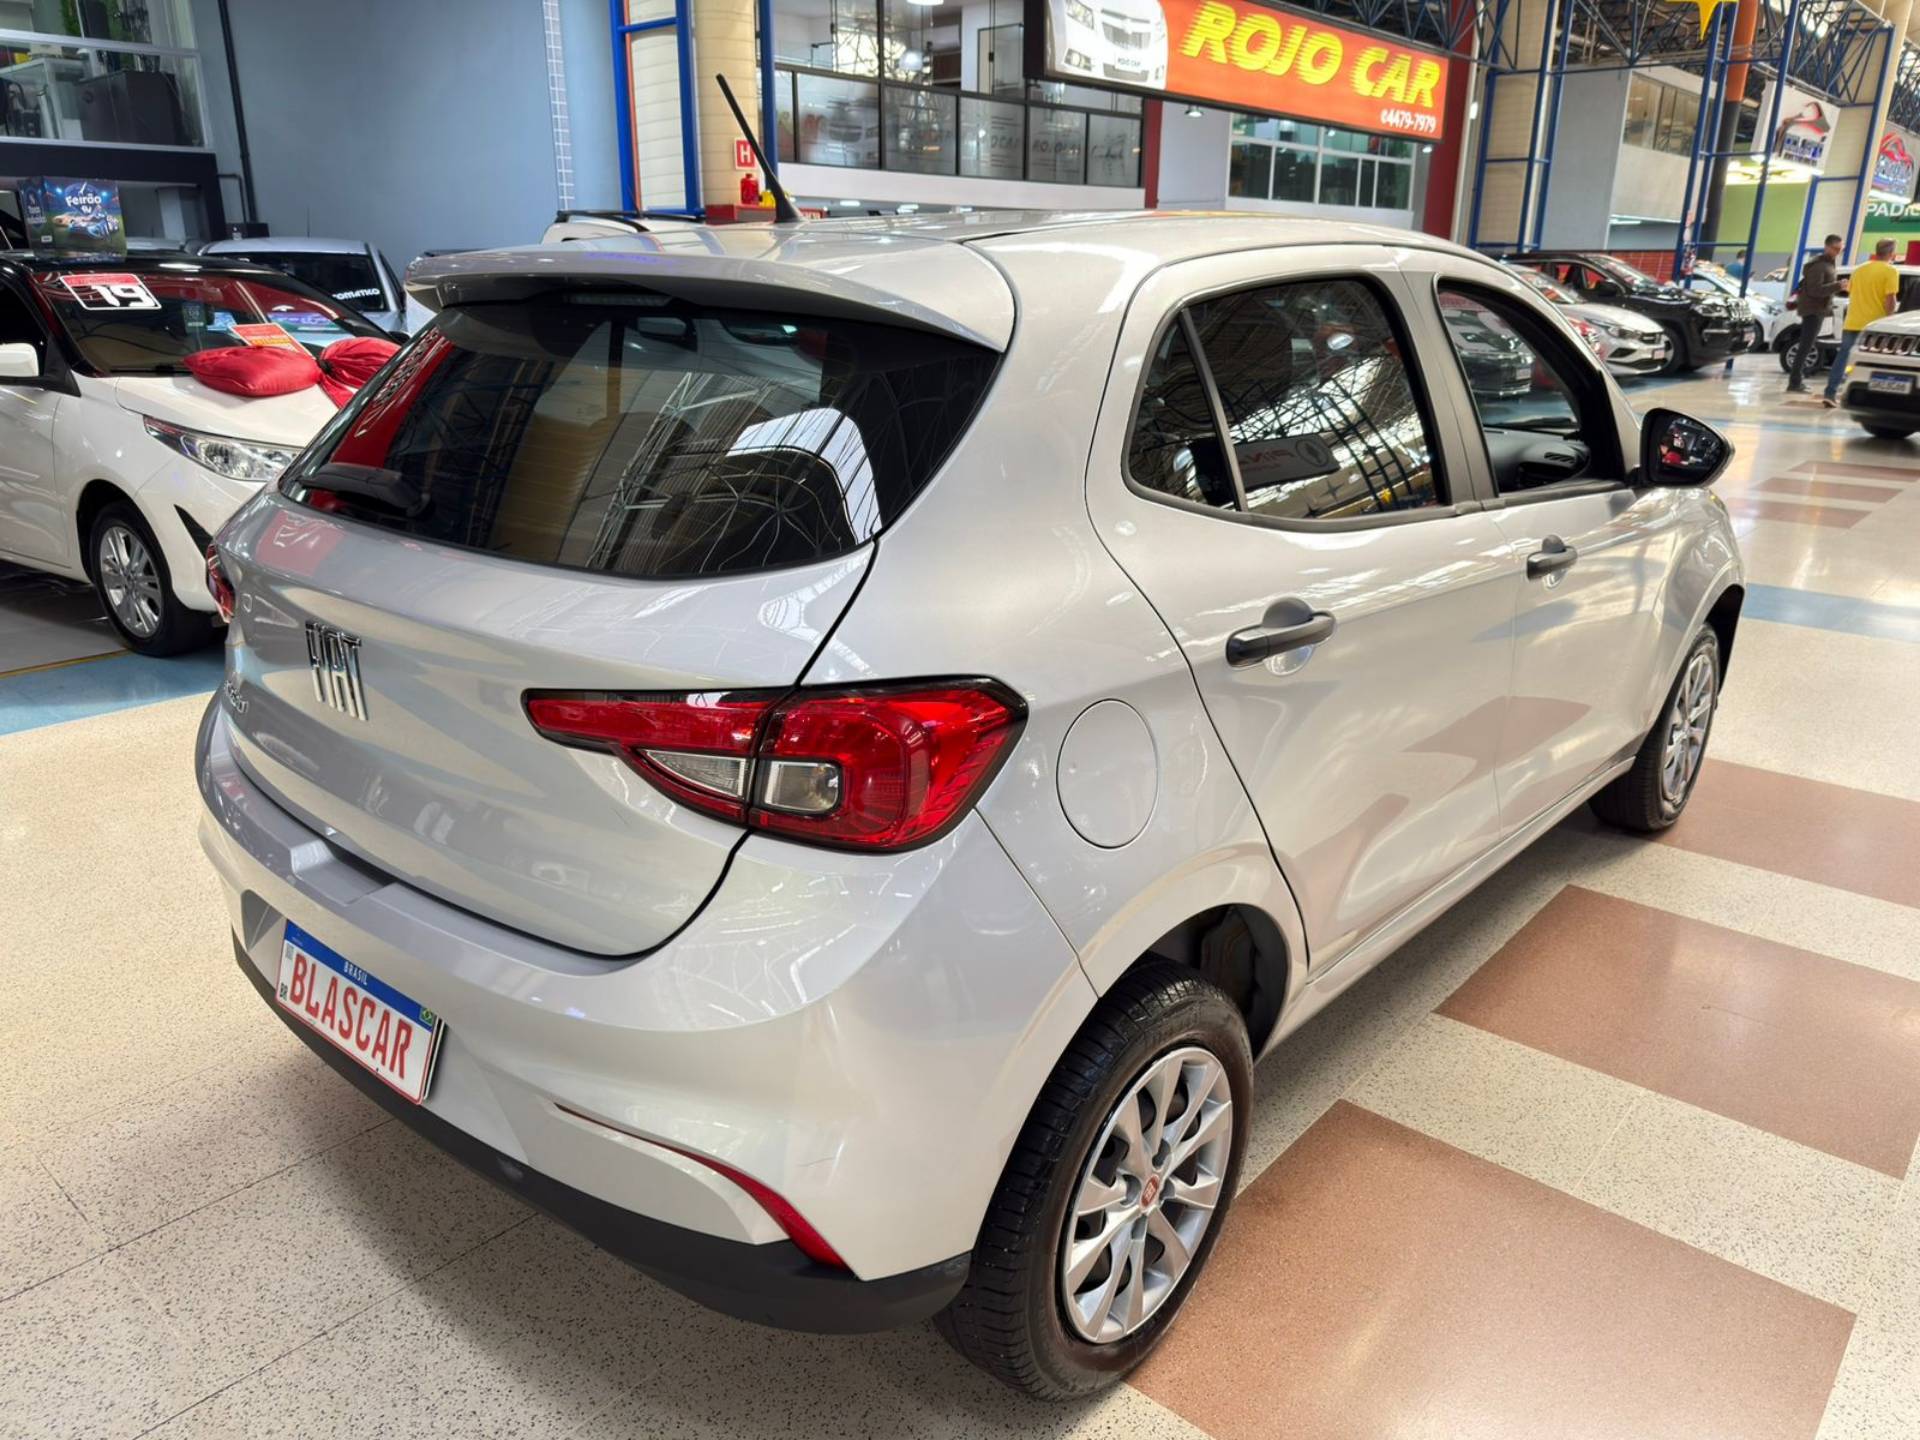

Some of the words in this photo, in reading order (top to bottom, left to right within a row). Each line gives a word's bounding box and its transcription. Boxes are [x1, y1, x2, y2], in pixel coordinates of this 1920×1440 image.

[1180, 1, 1343, 85] ROJO
[1352, 47, 1440, 108] CAR
[740, 144, 751, 164] H
[66, 193, 101, 207] Feirão
[91, 284, 155, 307] 19
[305, 620, 368, 721] FIAT
[343, 961, 368, 986] BRASIL
[290, 953, 413, 1080] BLASCAR
